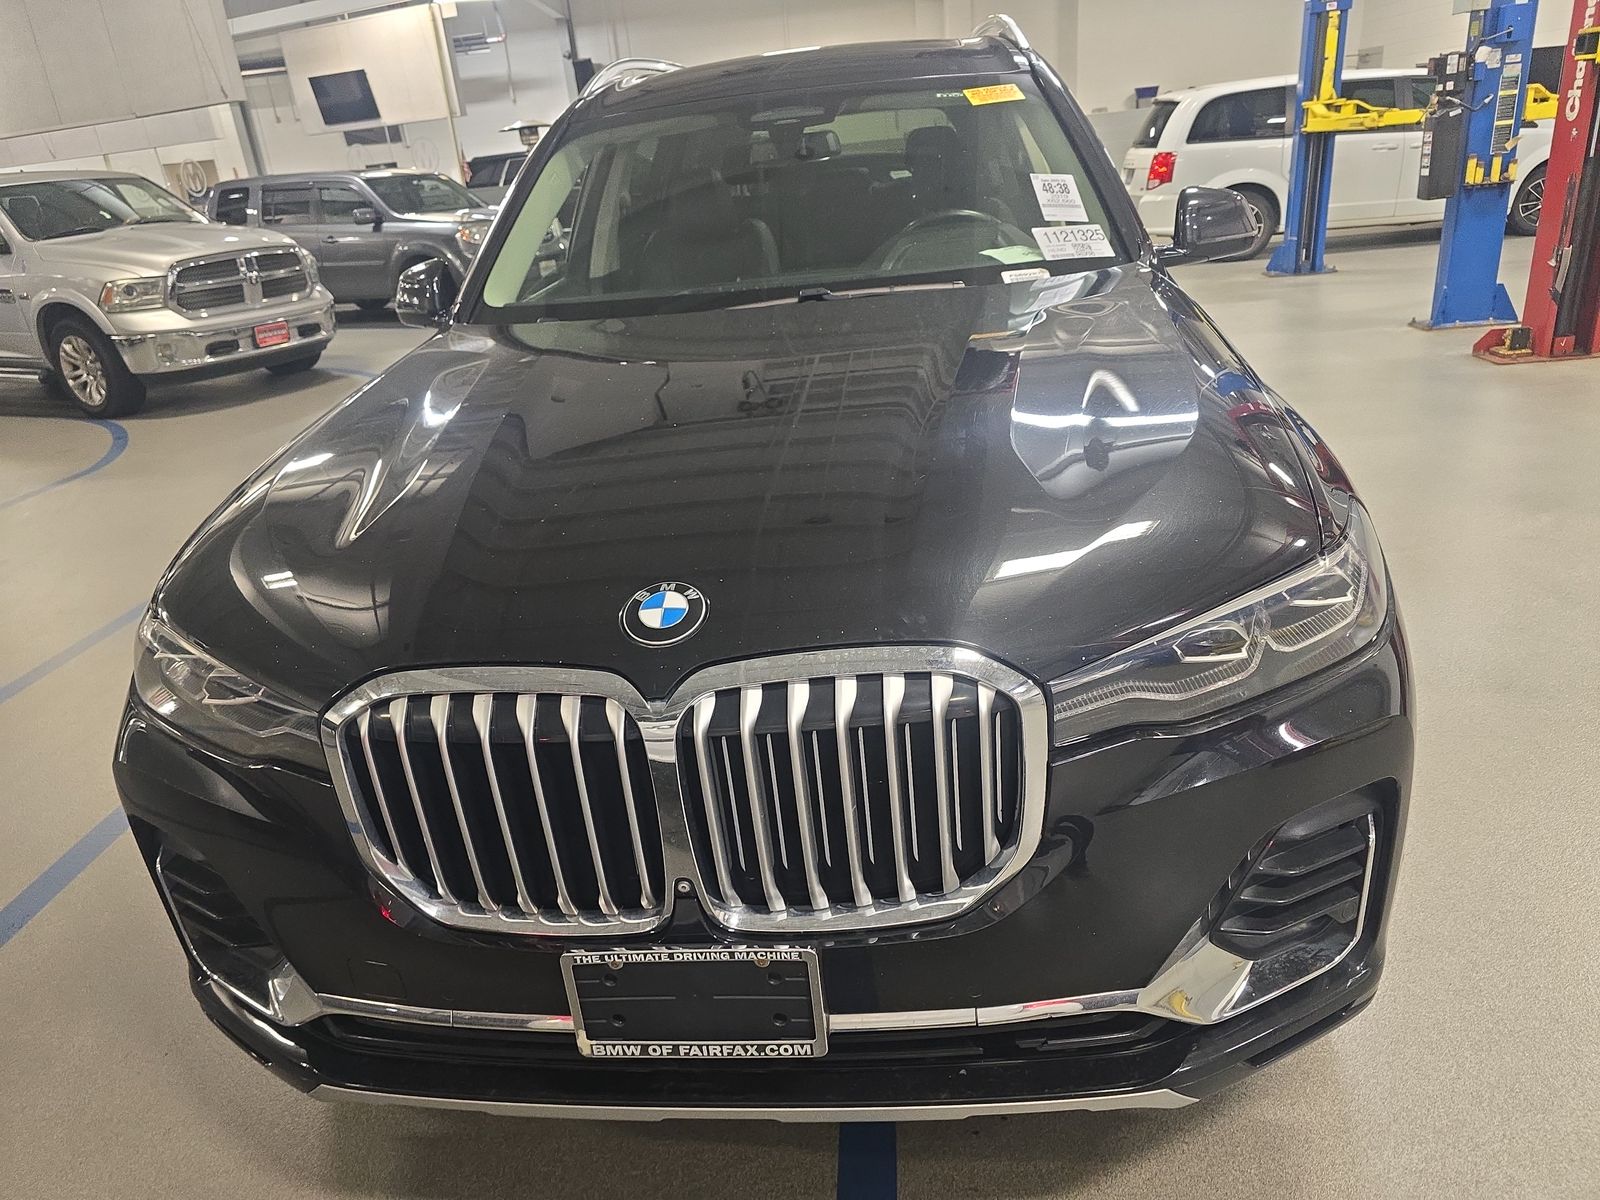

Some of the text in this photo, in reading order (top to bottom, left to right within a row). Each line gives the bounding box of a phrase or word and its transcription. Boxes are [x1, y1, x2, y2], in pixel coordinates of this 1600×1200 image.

[1042, 182, 1070, 195] 48:38
[1043, 229, 1106, 244] 1121325
[635, 583, 700, 602] BMW
[574, 951, 800, 964] THE ULTIMATE DRIVING MACHINE
[592, 1044, 812, 1057] BMW OF FAIRFAX.COM
